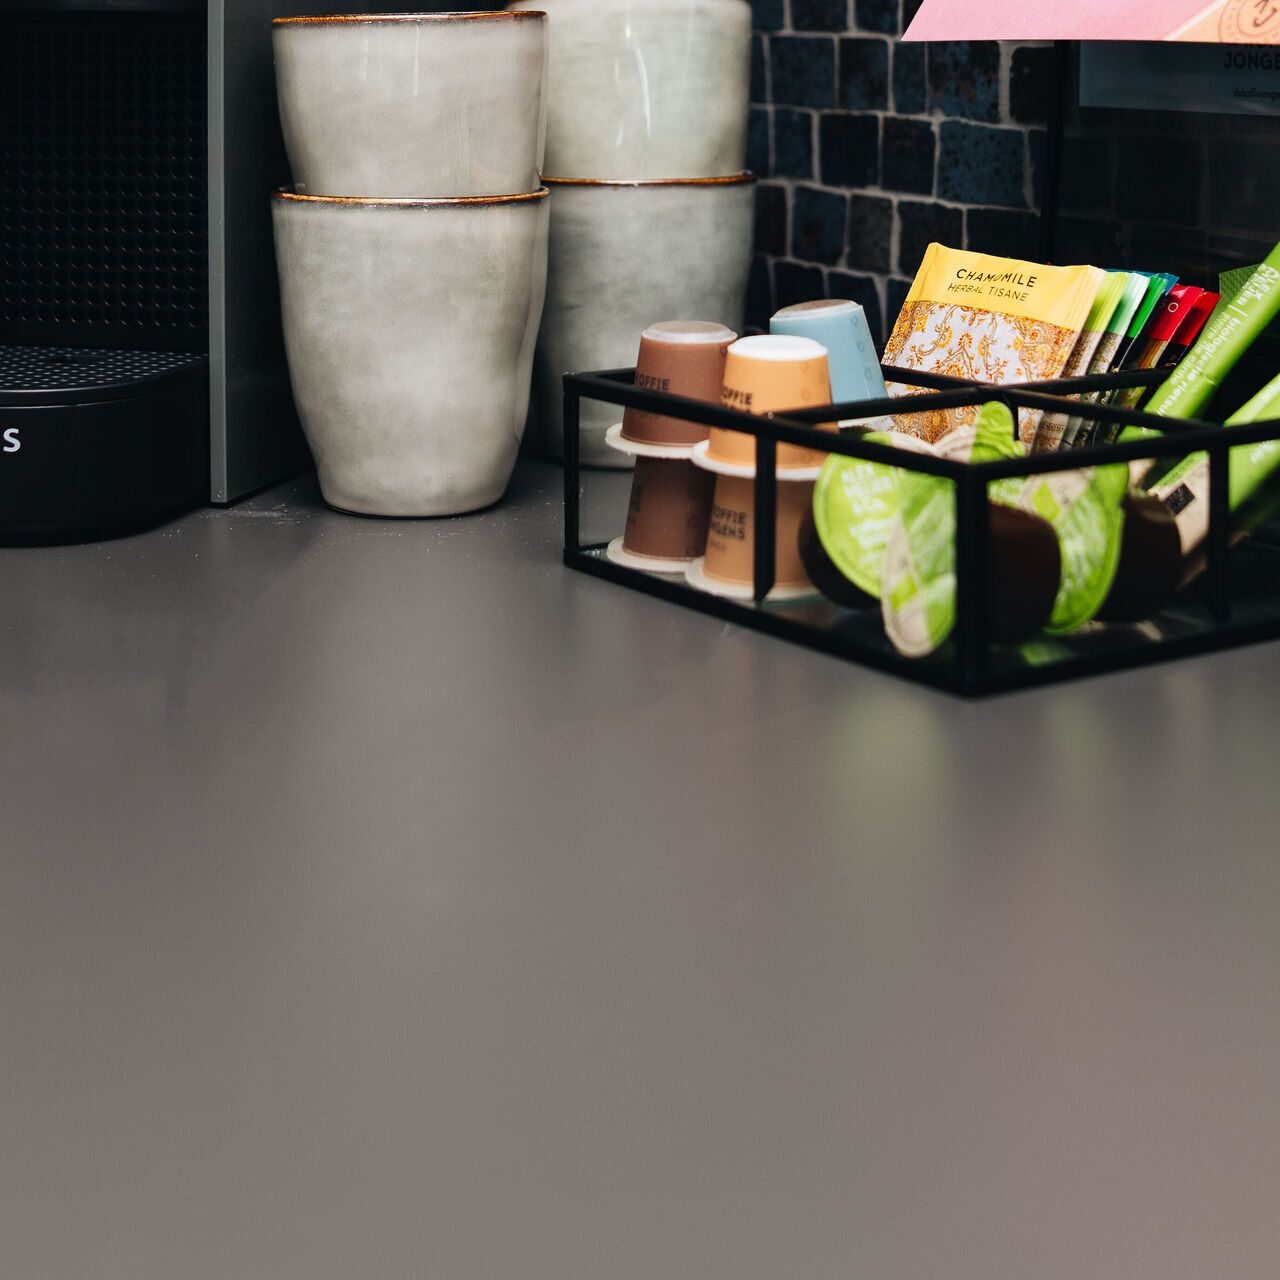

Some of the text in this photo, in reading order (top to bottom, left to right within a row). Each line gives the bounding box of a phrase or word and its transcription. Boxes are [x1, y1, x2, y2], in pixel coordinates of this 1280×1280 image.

[956, 268, 1037, 288] CHAMOMILE
[947, 283, 1029, 302] HERBAL TISANE
